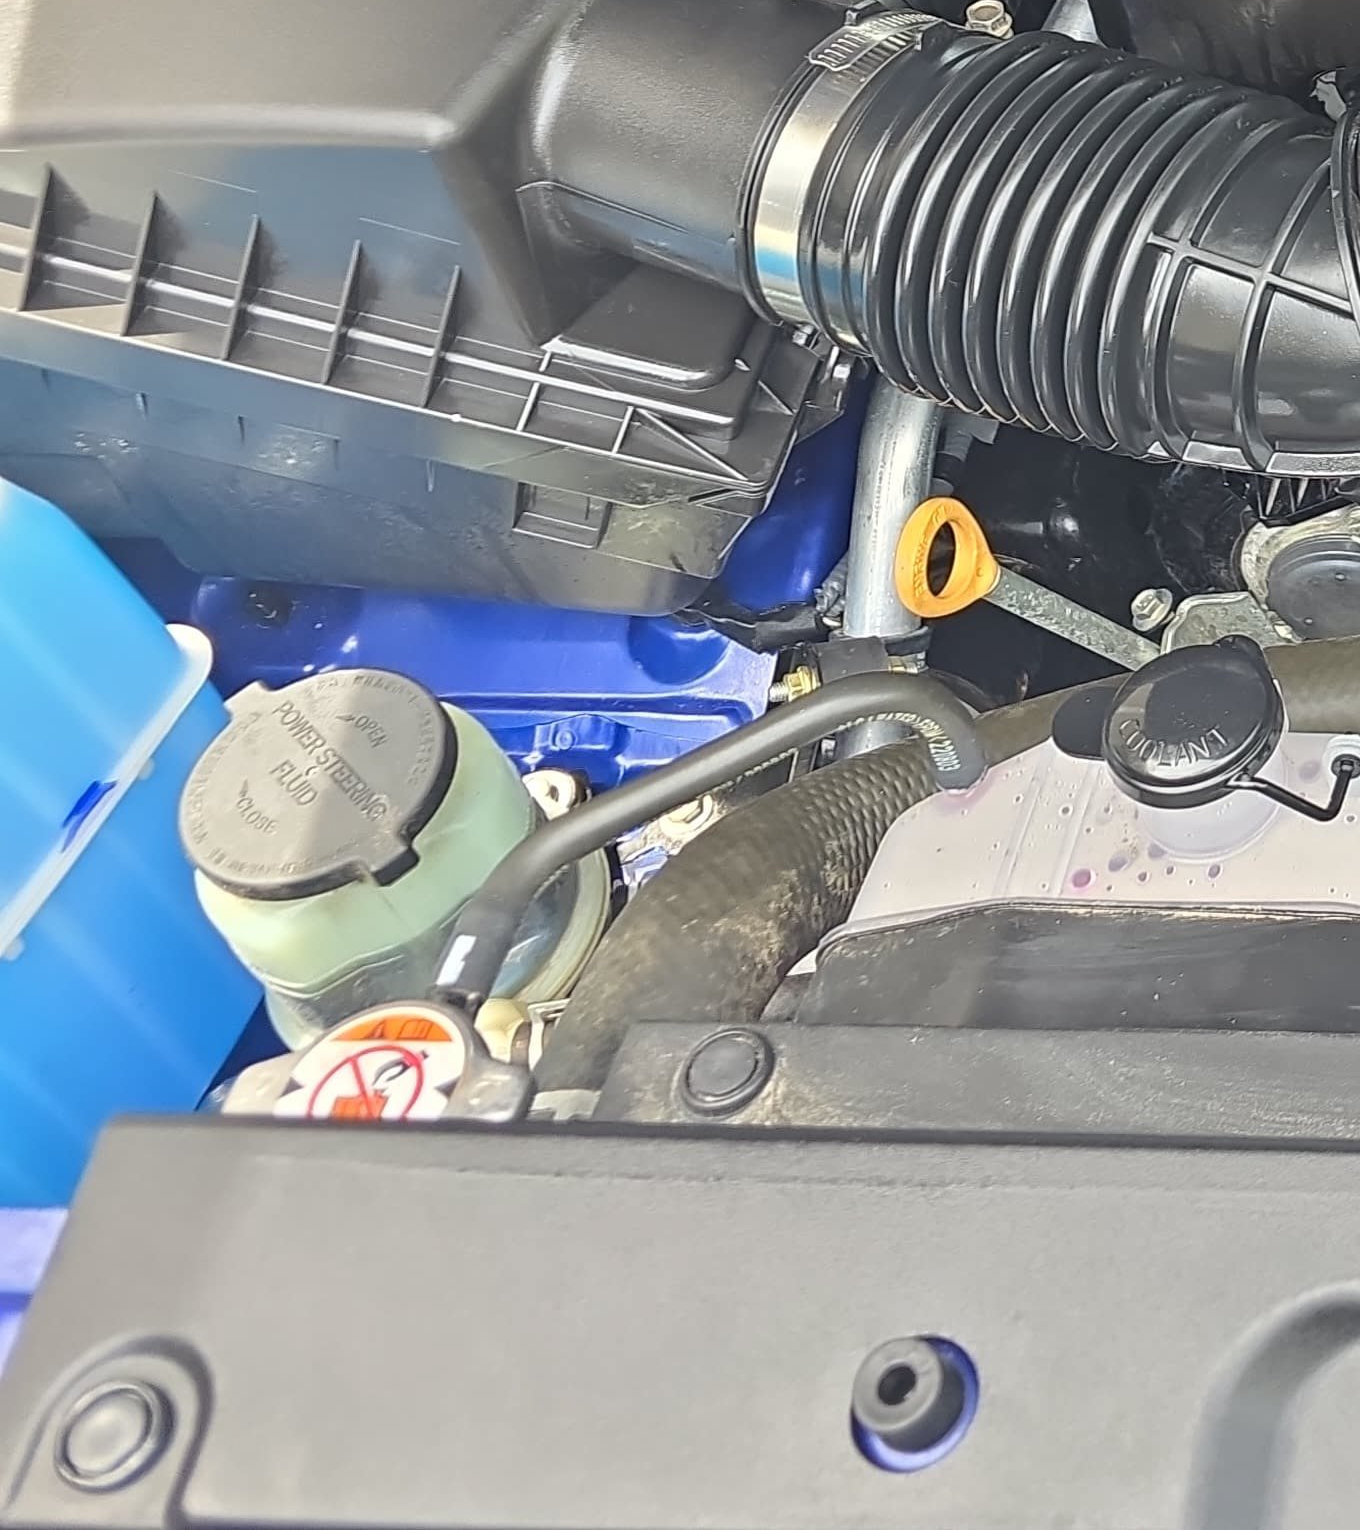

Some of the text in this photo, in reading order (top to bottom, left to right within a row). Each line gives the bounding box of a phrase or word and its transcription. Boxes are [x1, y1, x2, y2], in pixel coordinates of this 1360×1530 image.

[354, 715, 390, 749] OPEN
[1119, 719, 1228, 767] COOLANT
[270, 759, 319, 806] FLUID
[272, 700, 325, 755] POWER
[315, 746, 388, 822] STEERING
[235, 795, 278, 836] CLOSE
